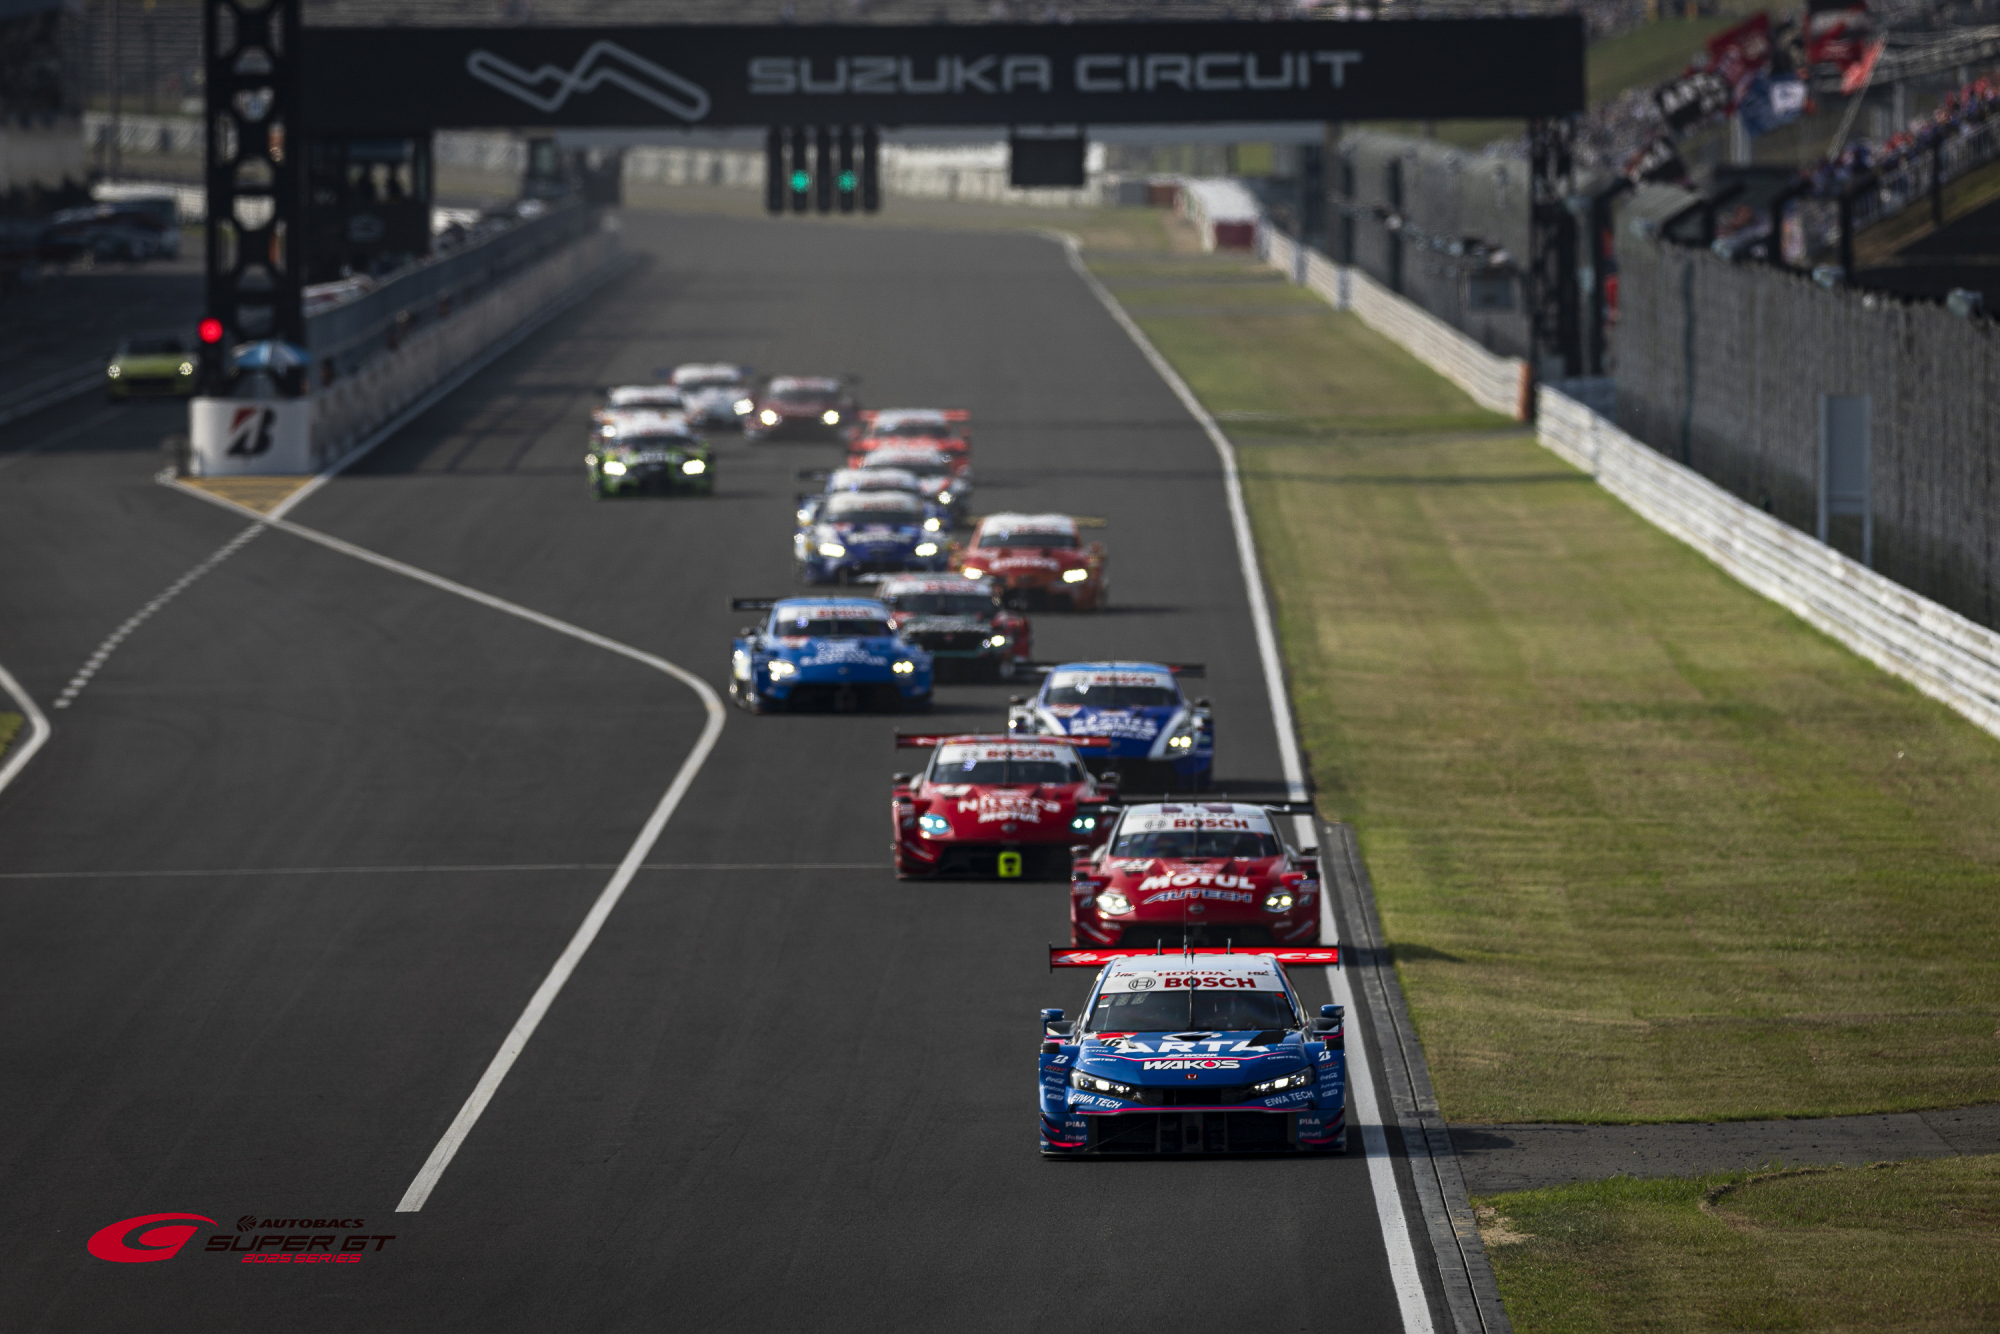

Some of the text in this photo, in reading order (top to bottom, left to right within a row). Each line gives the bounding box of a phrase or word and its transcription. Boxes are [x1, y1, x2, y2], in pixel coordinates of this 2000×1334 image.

[747, 51, 1363, 93] SUZUKA CIRCUIT
[1174, 818, 1249, 829] BOSCH
[1138, 874, 1256, 891] MOTUL
[1141, 888, 1253, 905] AUTECH
[1163, 977, 1257, 988] BOSCH
[1071, 1093, 1096, 1104] EIWA
[1095, 1097, 1123, 1109] TECH
[1264, 1095, 1290, 1107] EIWA
[1289, 1090, 1314, 1101] TECH
